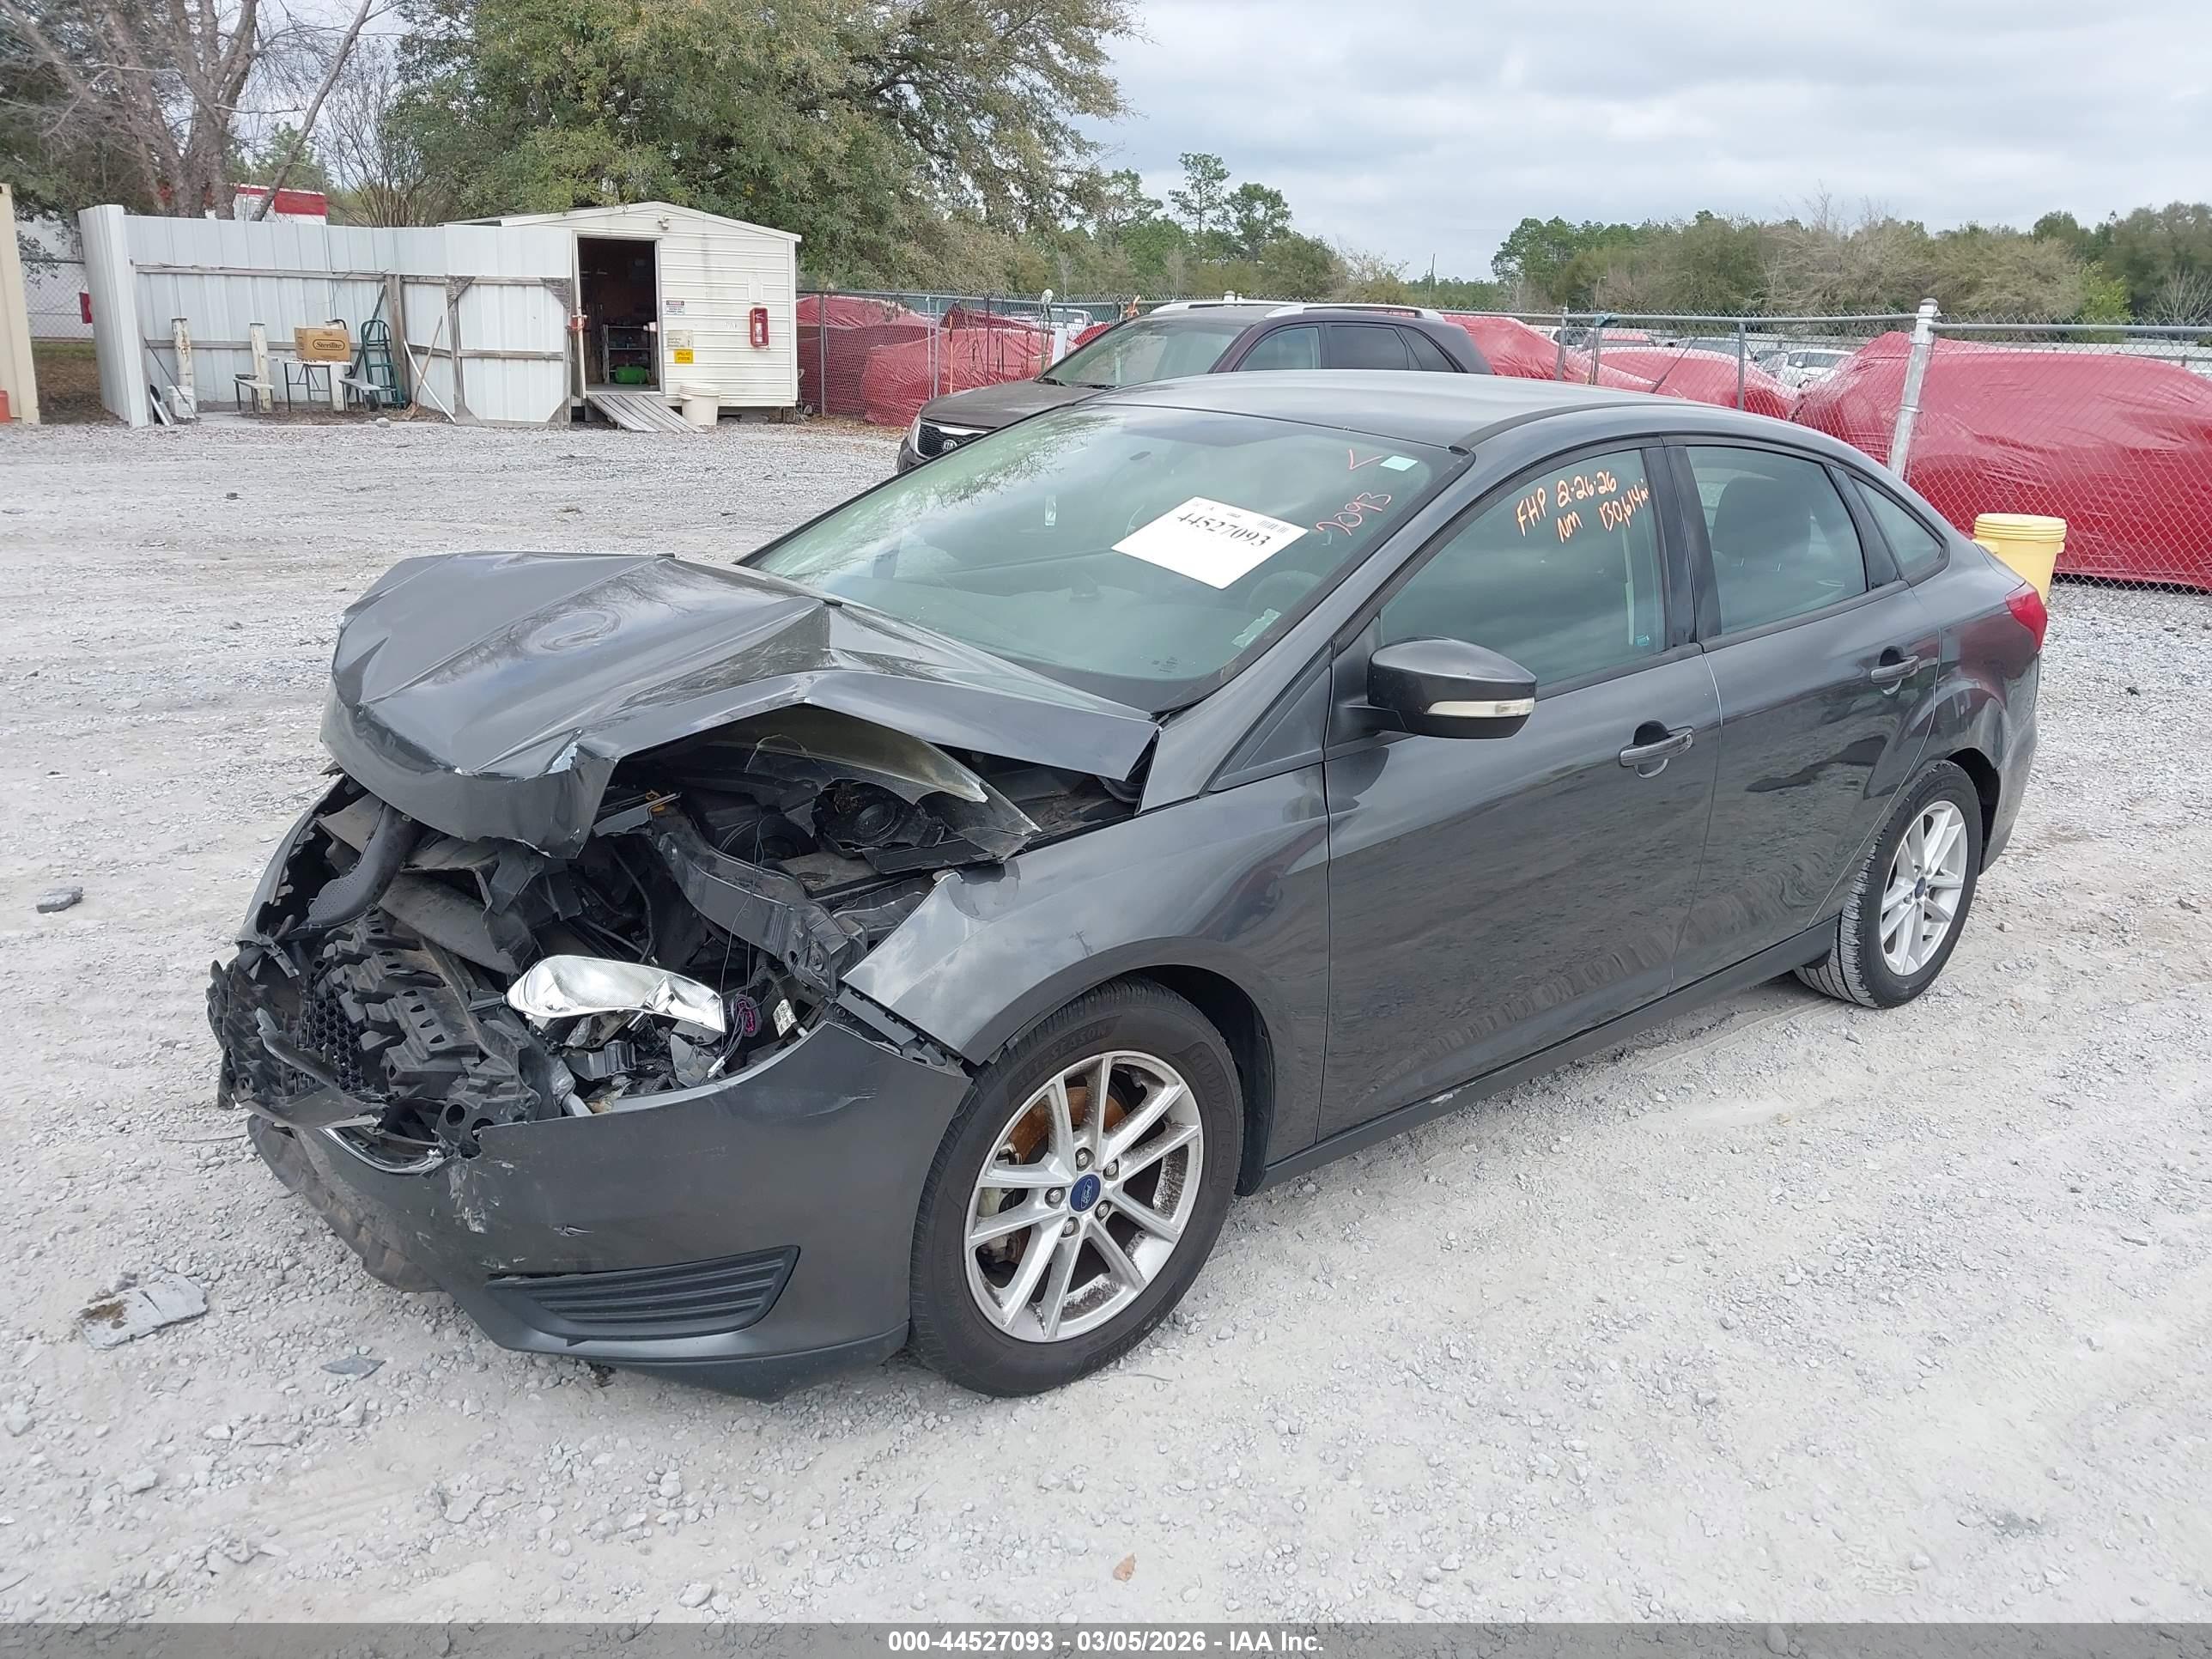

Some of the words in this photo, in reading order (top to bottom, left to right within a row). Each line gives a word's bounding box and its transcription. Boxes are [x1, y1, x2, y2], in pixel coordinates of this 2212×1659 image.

[1176, 512, 1272, 548] 44527093
[1316, 491, 1392, 538] 7093
[1516, 486, 1547, 538] FHP
